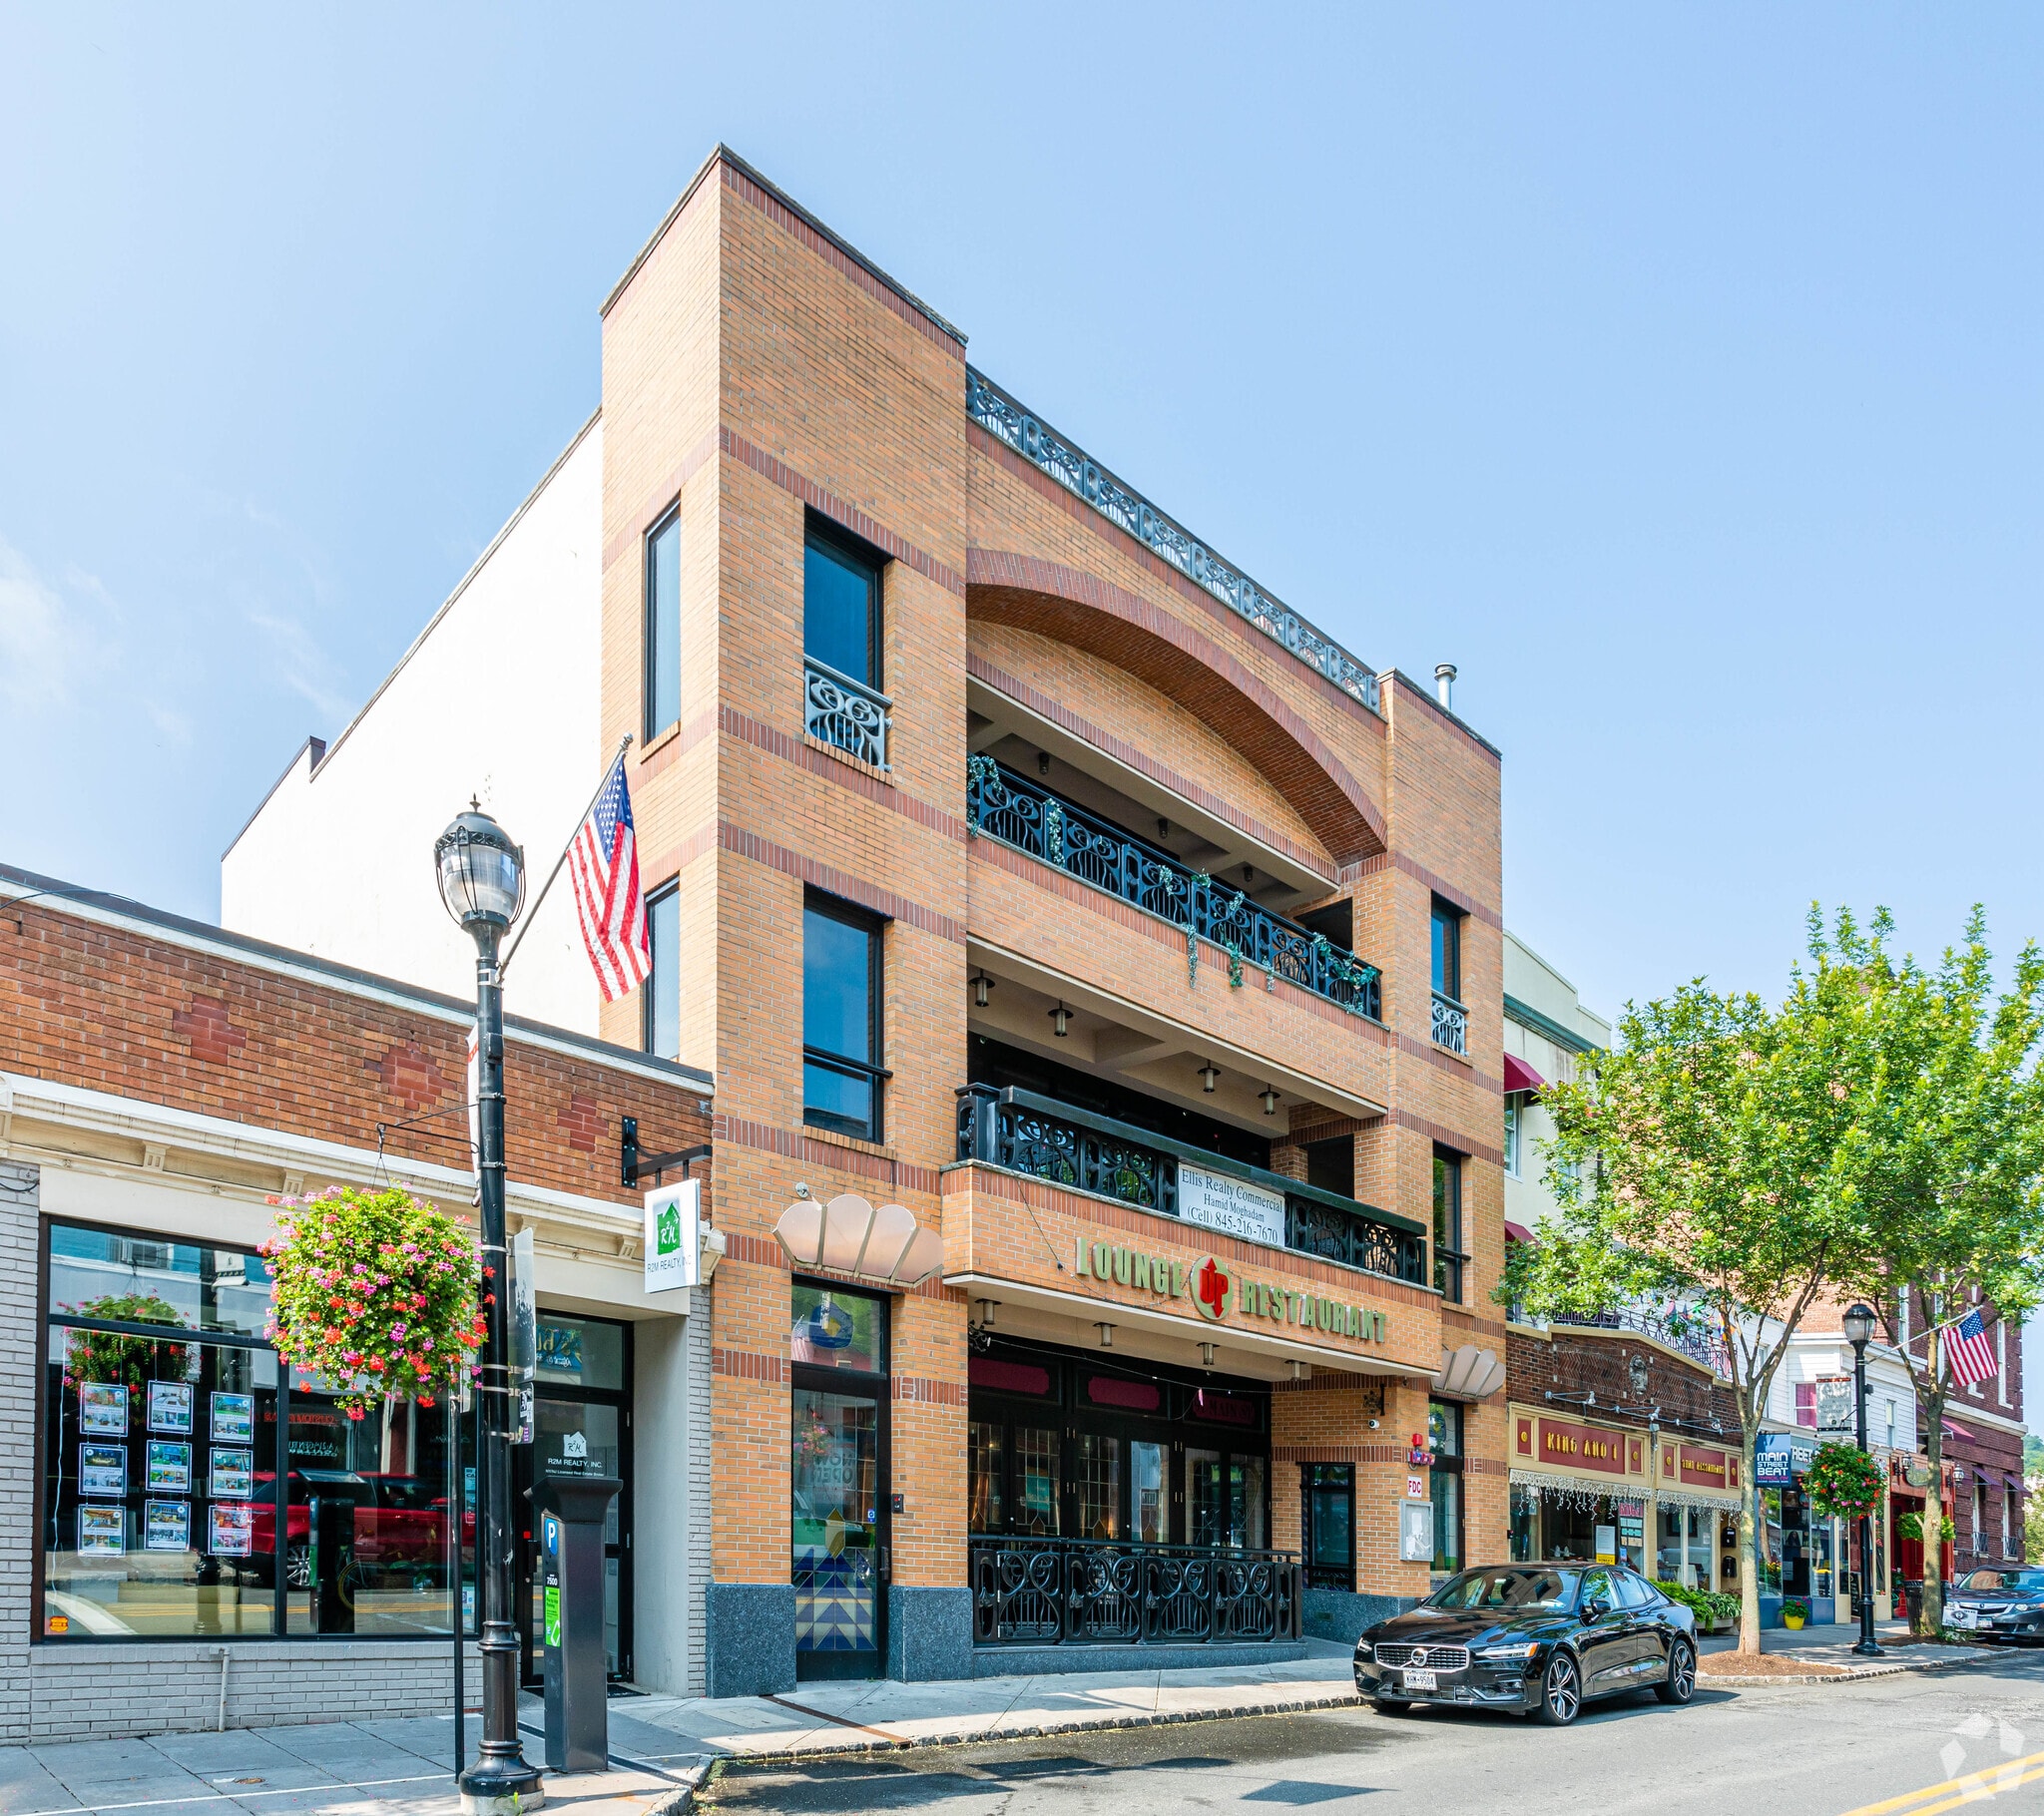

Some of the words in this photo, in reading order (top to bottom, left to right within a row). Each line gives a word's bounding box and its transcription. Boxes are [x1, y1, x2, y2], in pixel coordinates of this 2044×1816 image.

[1182, 1168, 1203, 1187] Ellis
[1206, 1175, 1235, 1199] Realty
[1237, 1185, 1282, 1213] Commercial
[1204, 1193, 1229, 1211] Hamid
[1230, 1201, 1265, 1222] Moghadam
[1187, 1205, 1213, 1224] (Cell)
[1215, 1211, 1278, 1244] 845-216-7670
[647, 1262, 659, 1273] R2M
[1076, 1236, 1185, 1297] LOUNGE
[1199, 1261, 1229, 1313] UP
[1240, 1277, 1386, 1343] RESTAURANT
[1547, 1432, 1578, 1455] KING
[1584, 1439, 1607, 1460] AND
[1613, 1443, 1618, 1462] I
[1757, 1452, 1788, 1462] MAIN
[563, 1459, 590, 1468] REALTY,
[1408, 1481, 1421, 1493] FDC
[548, 1522, 556, 1548] P
[547, 1577, 558, 1586] 7500
